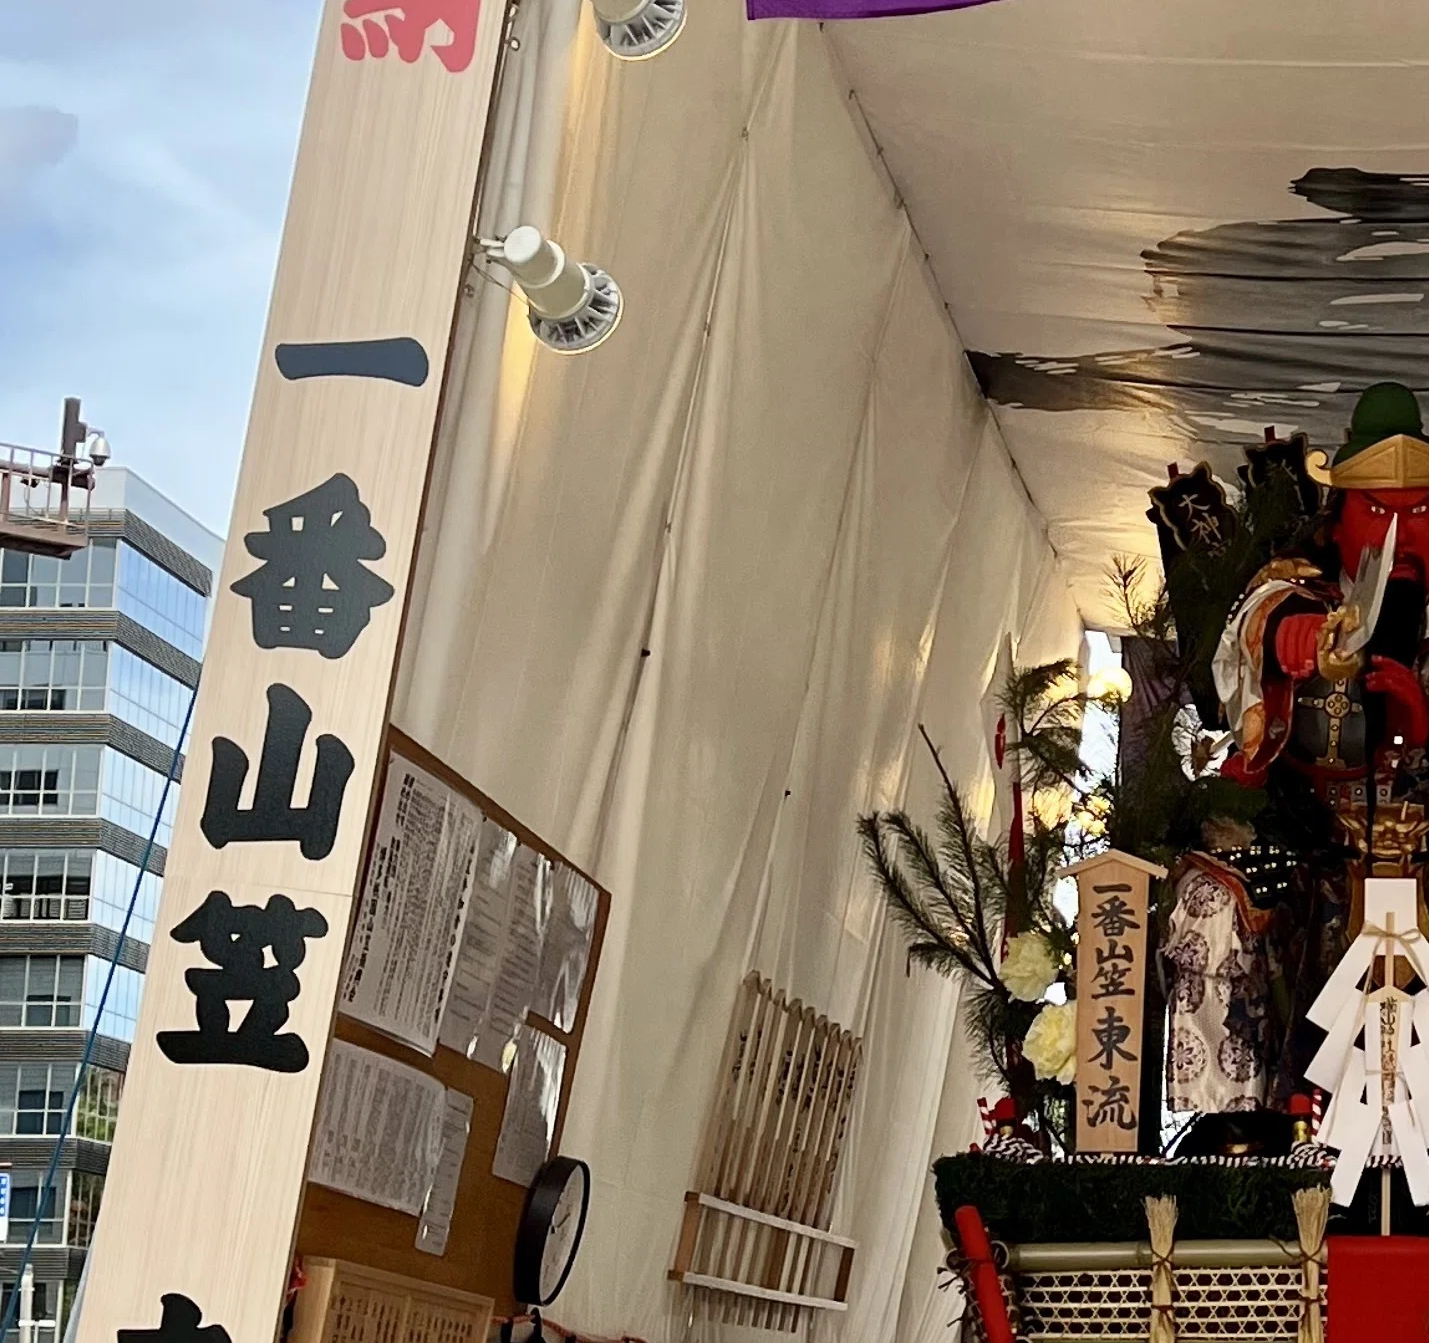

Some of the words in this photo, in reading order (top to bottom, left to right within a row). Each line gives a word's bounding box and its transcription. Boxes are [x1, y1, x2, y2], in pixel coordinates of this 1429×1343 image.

[156, 337, 430, 1075] 一番山笠
[1082, 884, 1140, 1132] 一番山笠東流
